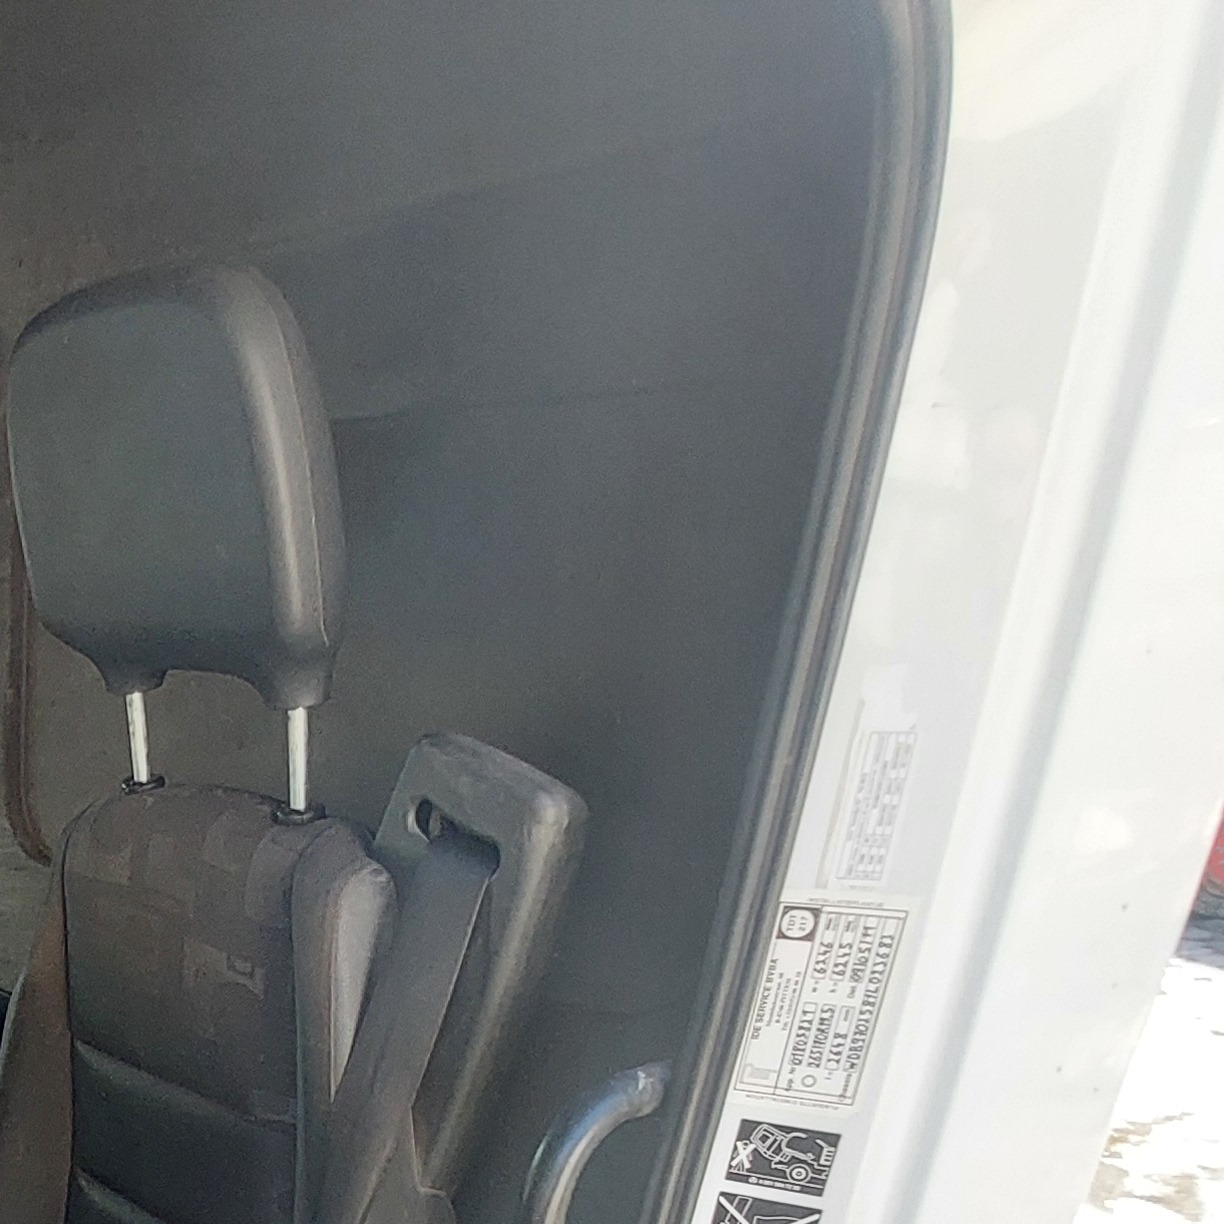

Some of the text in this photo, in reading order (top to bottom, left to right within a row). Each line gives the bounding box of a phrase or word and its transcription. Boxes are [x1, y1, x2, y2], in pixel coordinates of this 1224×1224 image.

[812, 940, 834, 974] 6246
[830, 941, 853, 976] 6245
[754, 985, 771, 1023] SERVICE
[764, 957, 778, 983] BVBA
[826, 1031, 848, 1064] 2648
